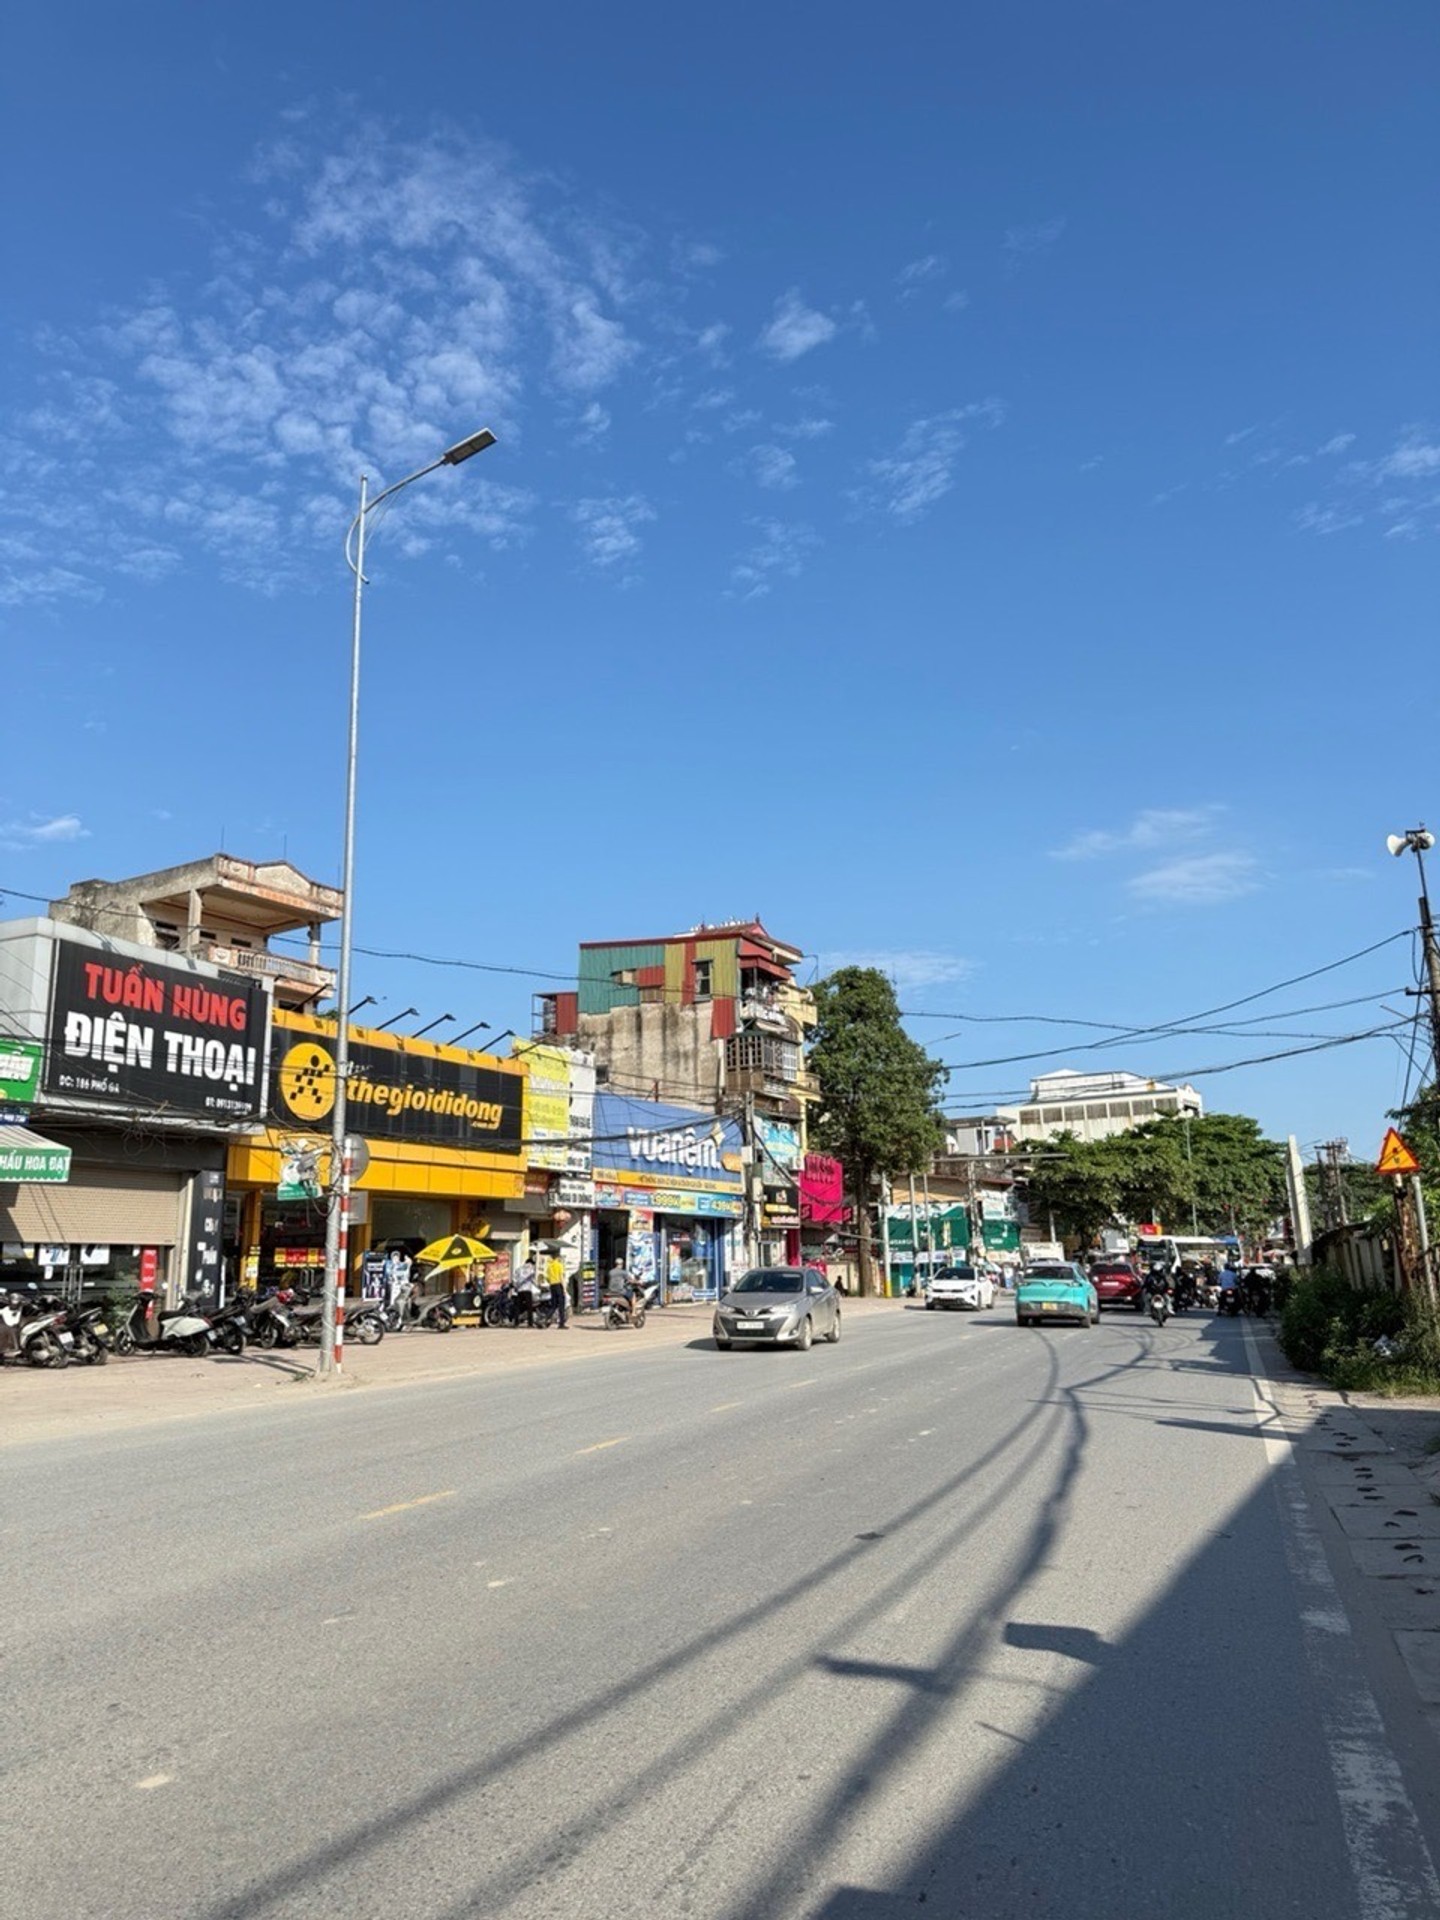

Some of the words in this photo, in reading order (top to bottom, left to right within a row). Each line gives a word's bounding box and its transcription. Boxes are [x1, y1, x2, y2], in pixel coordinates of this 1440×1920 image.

[85, 963, 165, 1014] TUẤN
[172, 983, 247, 1031] HÙNG
[64, 1011, 154, 1073] ĐIỆN
[163, 1031, 256, 1091] THOẠI
[346, 1076, 503, 1130] thegioididong
